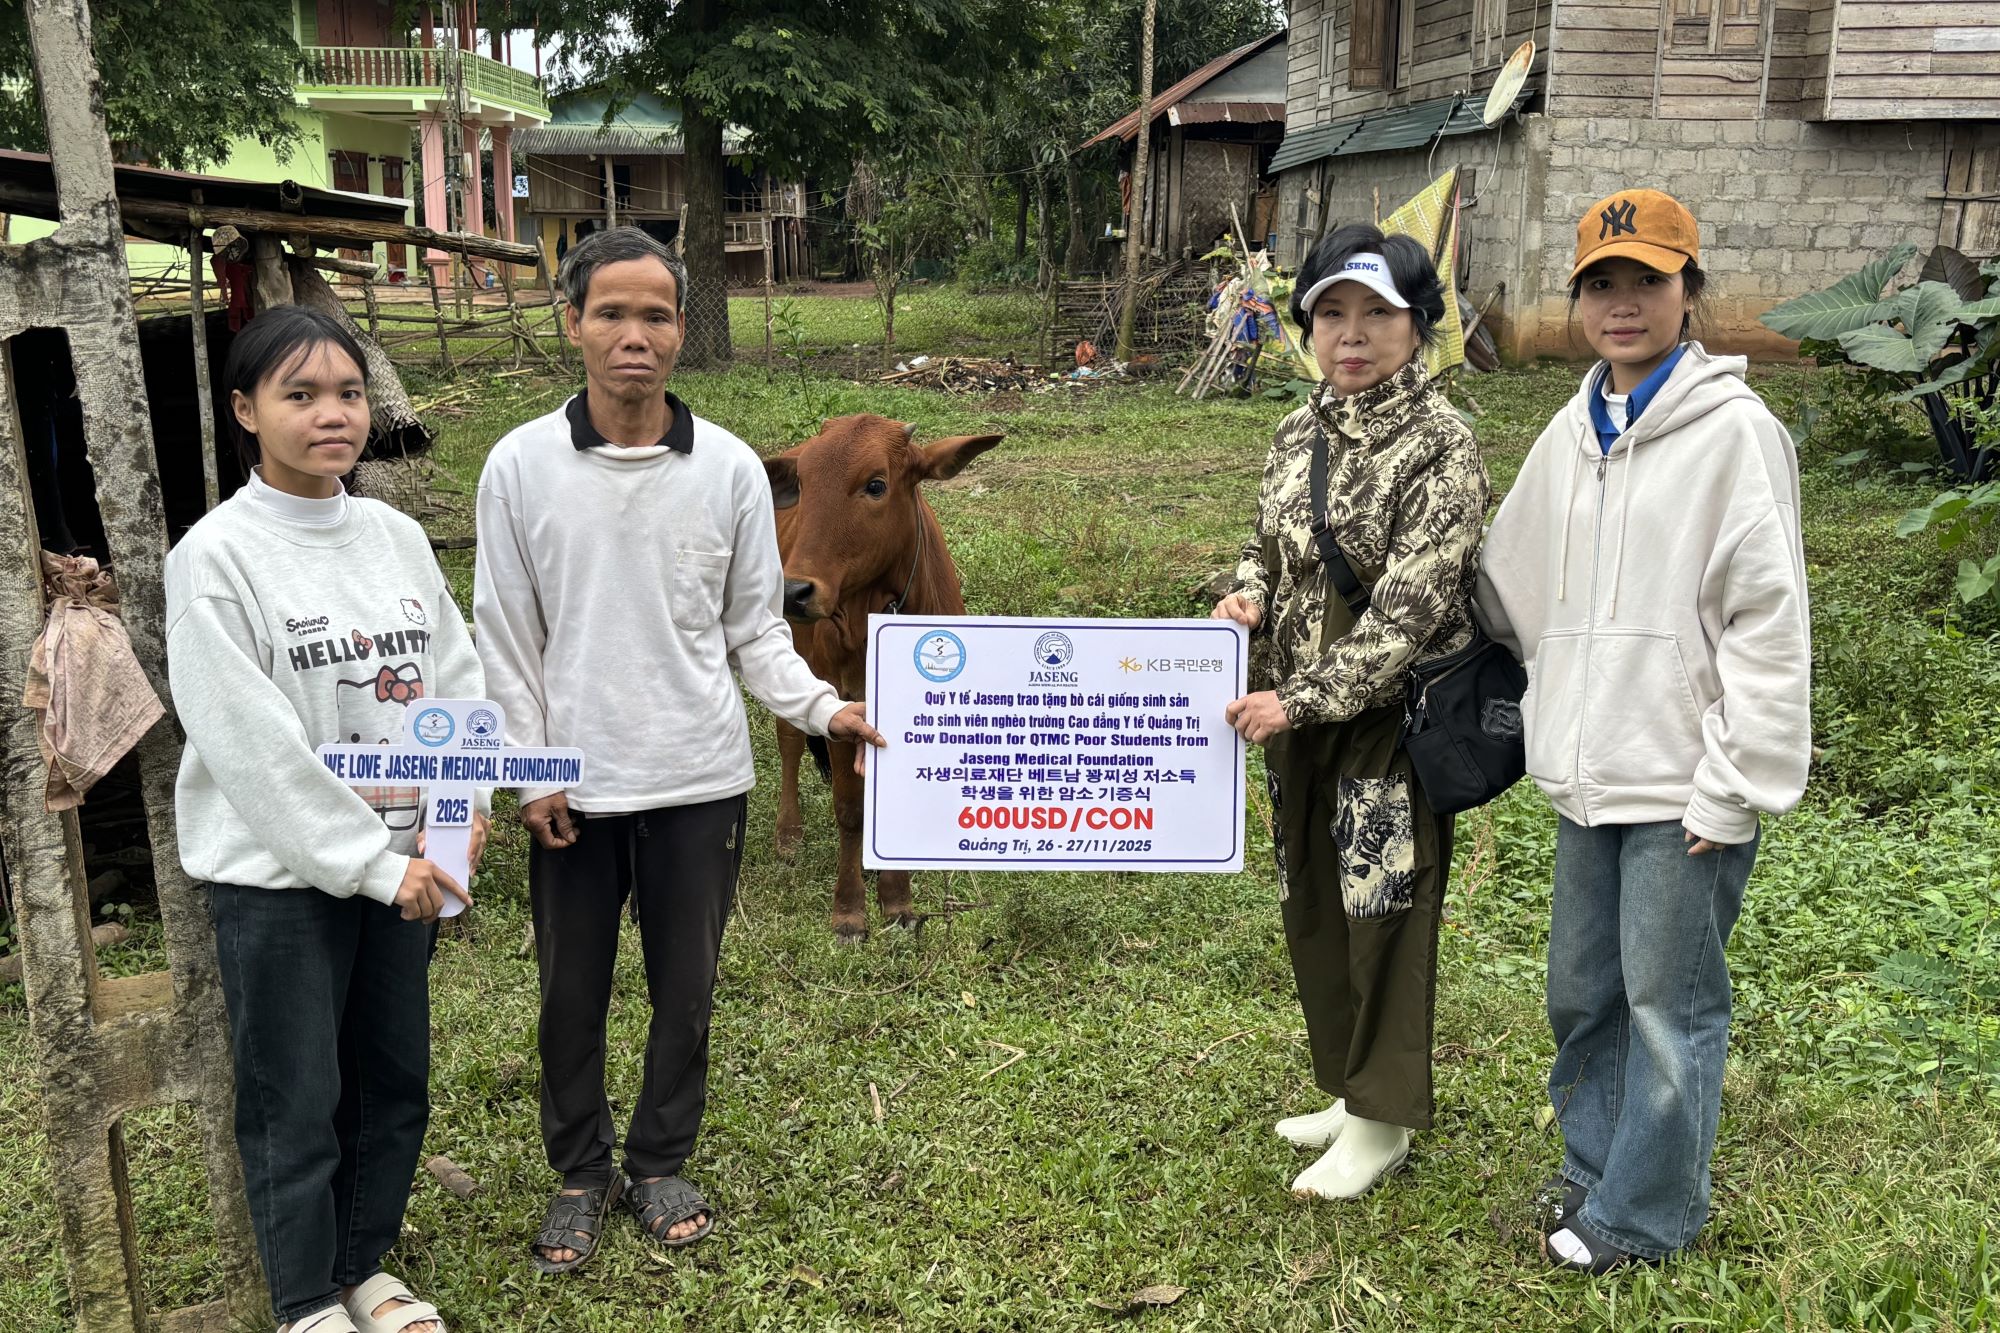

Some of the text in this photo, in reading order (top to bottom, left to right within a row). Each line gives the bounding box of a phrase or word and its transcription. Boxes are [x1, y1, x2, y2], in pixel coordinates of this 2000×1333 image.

[1599, 199, 1637, 241] NY
[1343, 262, 1379, 272] SENG
[288, 637, 371, 671] HELLO
[1147, 658, 1223, 673] KB 국민은행
[1028, 671, 1079, 683] JASENG
[925, 689, 1190, 709] Quỹ Y tế Jaseng trao tặng bò cái giống sinh sản
[913, 711, 1200, 732] cho sinh viên nghèo trường Cao đẳng Y tế Quảng Trị
[461, 738, 500, 747] JASENG
[904, 731, 1209, 747] Cow Donation for QTMC Poor Students from
[323, 753, 581, 782] WE LOVE JASENG MEDICAL FOUNDATION
[959, 752, 1154, 767] Jaseng Medical Foundation
[916, 767, 1197, 784] 자생의료재단 베트남 꽝찌성 저소득
[961, 785, 1151, 802] 학생을 위한 암소 기증식
[436, 798, 469, 823] 2025
[958, 806, 1154, 832] 600USD/CON
[958, 837, 1008, 854] Quảng
[1012, 839, 1032, 854] Trị,
[1036, 839, 1054, 852] 26
[1066, 839, 1152, 853] 27/11/2025
